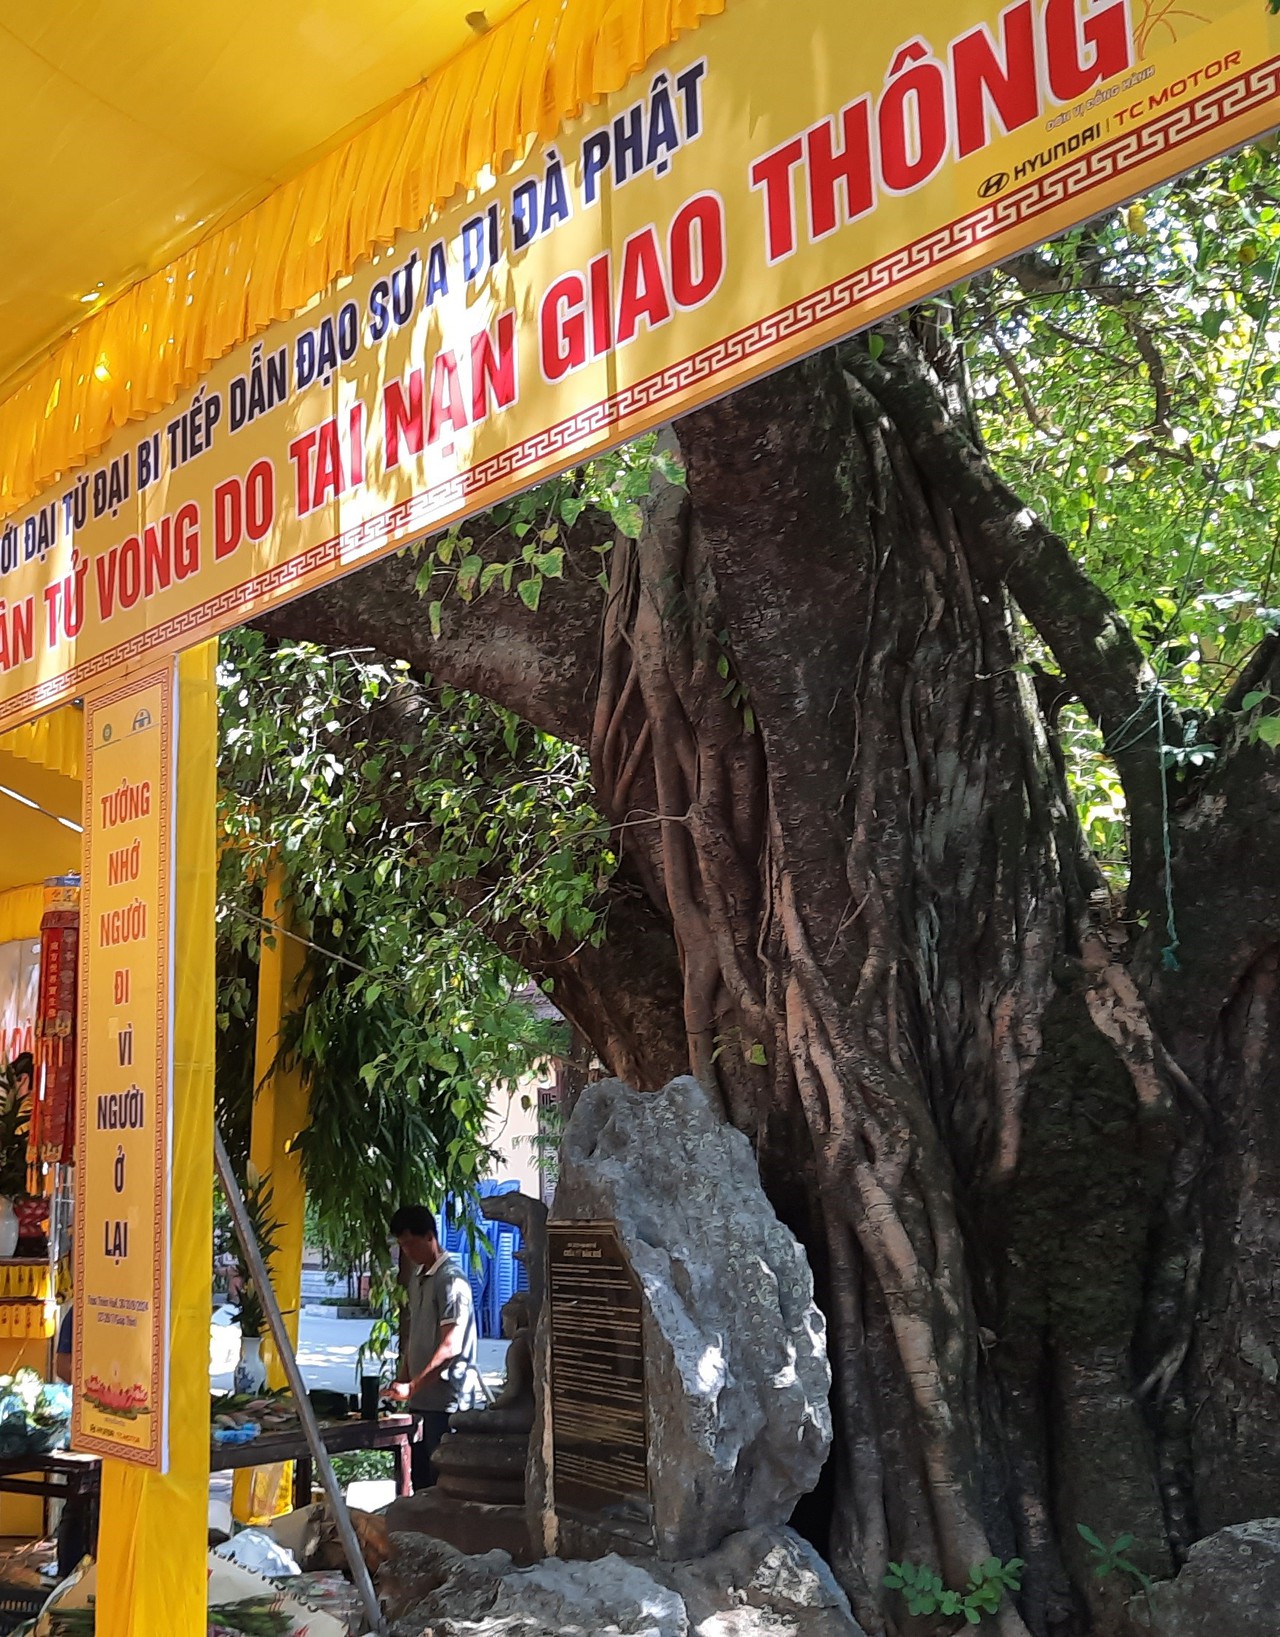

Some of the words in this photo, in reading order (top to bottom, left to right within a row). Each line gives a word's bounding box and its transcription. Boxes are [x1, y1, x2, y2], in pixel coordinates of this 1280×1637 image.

[1122, 65, 1155, 92] HÀNH
[1014, 122, 1101, 181] HYUNDAI
[1114, 105, 1144, 126] TC
[1148, 50, 1241, 111] MOTOR
[23, 499, 57, 560] ĐẠI
[61, 474, 92, 536] TỪ
[93, 455, 130, 519] ĐẠI
[136, 438, 161, 492] BI
[168, 387, 221, 470] TIẾP
[229, 345, 287, 431] DẪN
[295, 303, 358, 390] ĐẠO
[370, 248, 420, 343] SƯ
[425, 241, 450, 308] A
[462, 203, 499, 284] DI
[512, 153, 569, 249] ĐÀ
[584, 62, 707, 204] PHẬT
[44, 550, 89, 648] TỬ
[96, 504, 199, 621] VONG
[214, 460, 273, 560] DO
[289, 405, 364, 516] TAI
[385, 312, 518, 470] NẠN
[540, 196, 722, 382] GIAO
[753, 0, 1130, 260] THÔNG
[101, 778, 150, 829] TƯỞNG
[109, 838, 140, 887] NHỚ
[100, 898, 146, 948] NGƯỜI
[114, 969, 129, 1005] ĐI
[118, 1023, 132, 1066] VÌ
[97, 1084, 144, 1130] NGƯỜI
[114, 1145, 125, 1193] Ở
[105, 1220, 128, 1267] LẠI
